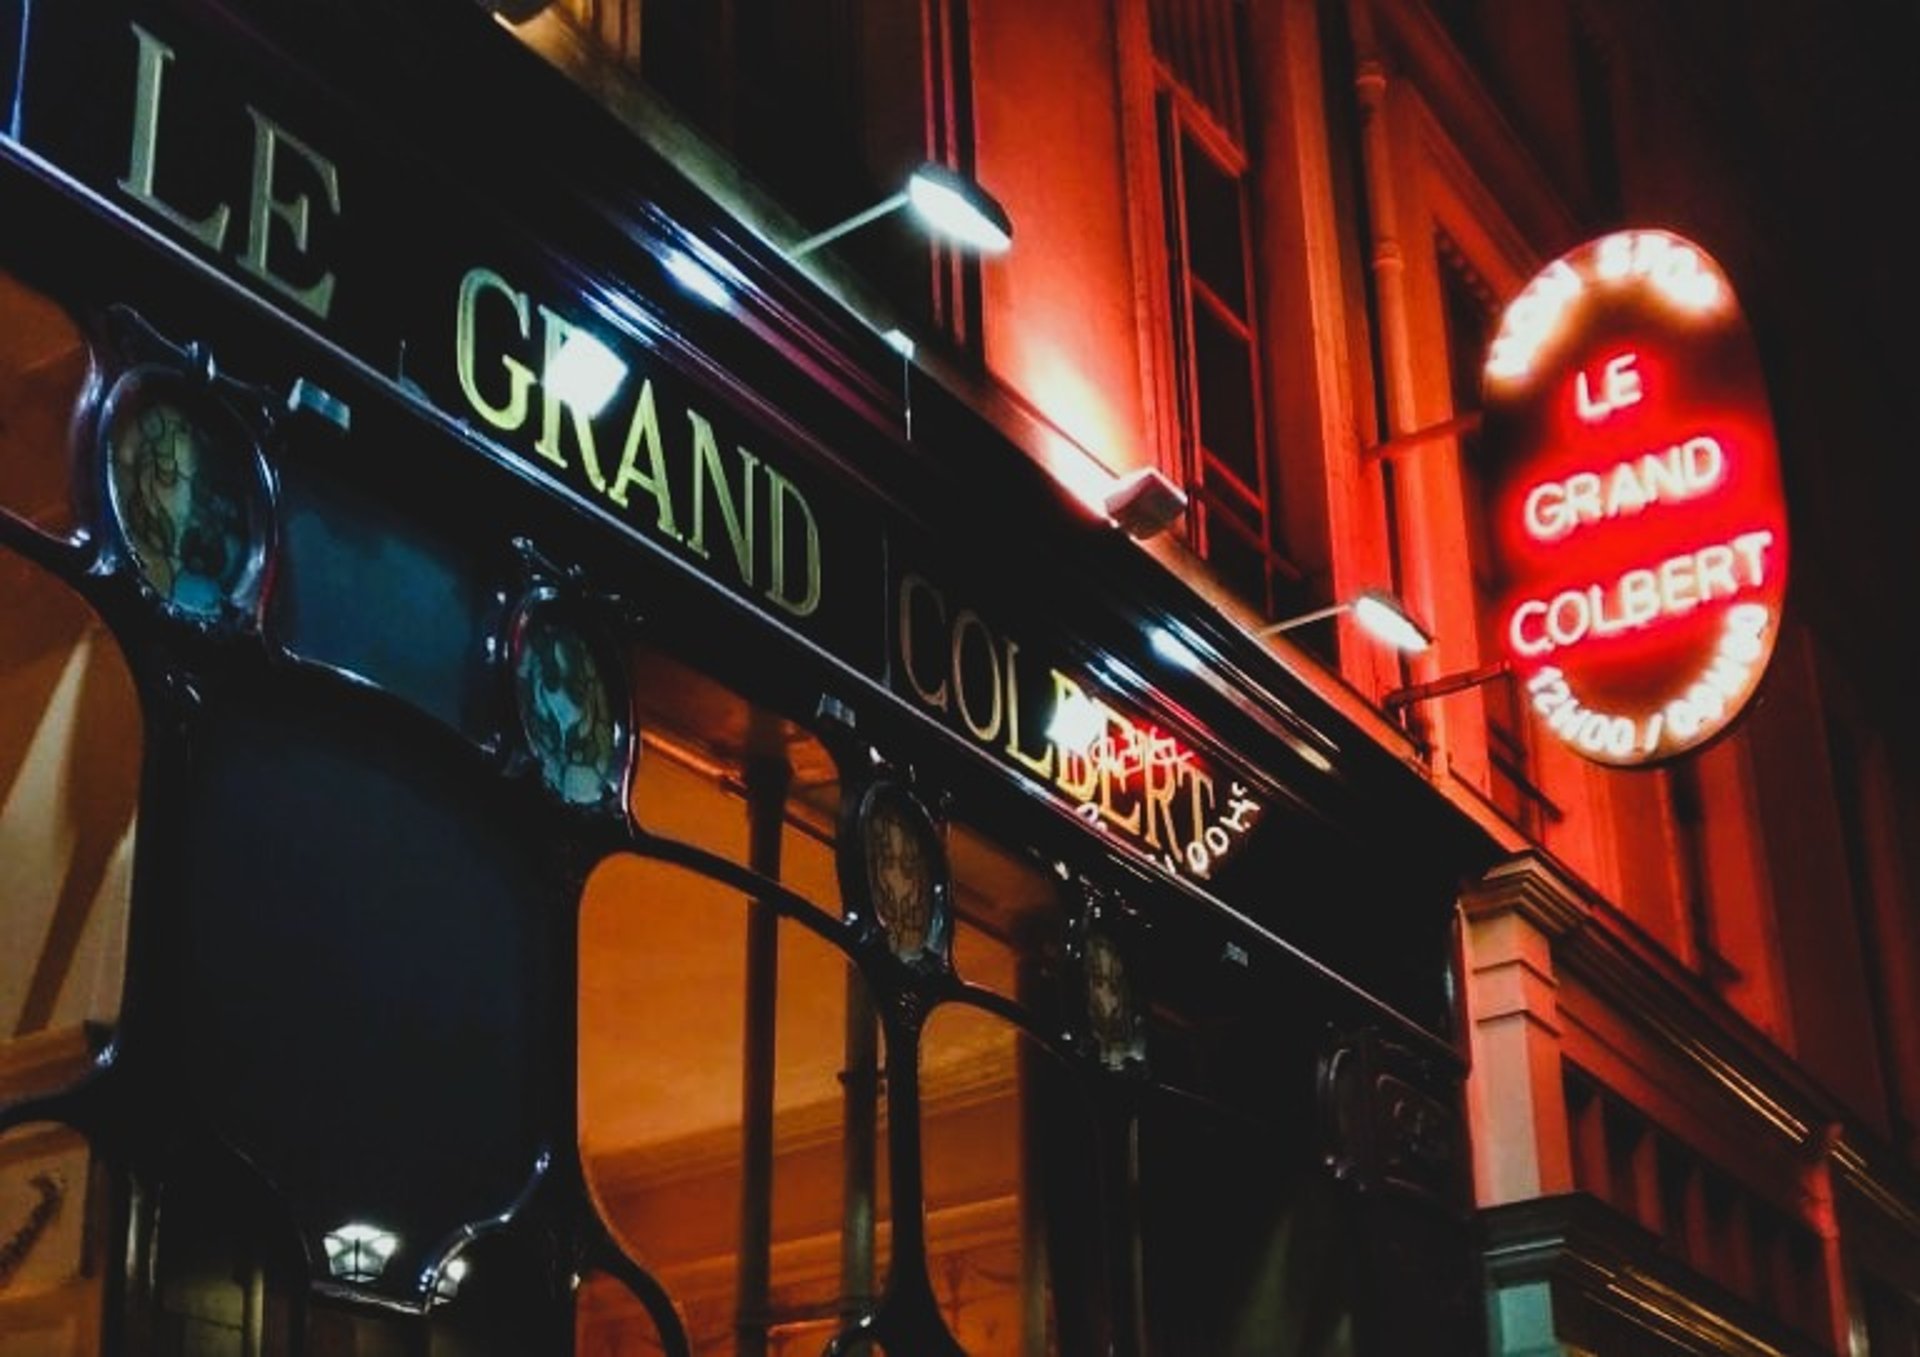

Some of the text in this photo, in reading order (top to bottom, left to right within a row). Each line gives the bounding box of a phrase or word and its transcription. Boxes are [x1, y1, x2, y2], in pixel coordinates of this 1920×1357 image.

[117, 20, 1216, 864] LE GRAND COLBERT
[1574, 353, 1643, 421] LE
[1524, 435, 1724, 540] GRAND
[1509, 530, 1774, 656] COLBERT
